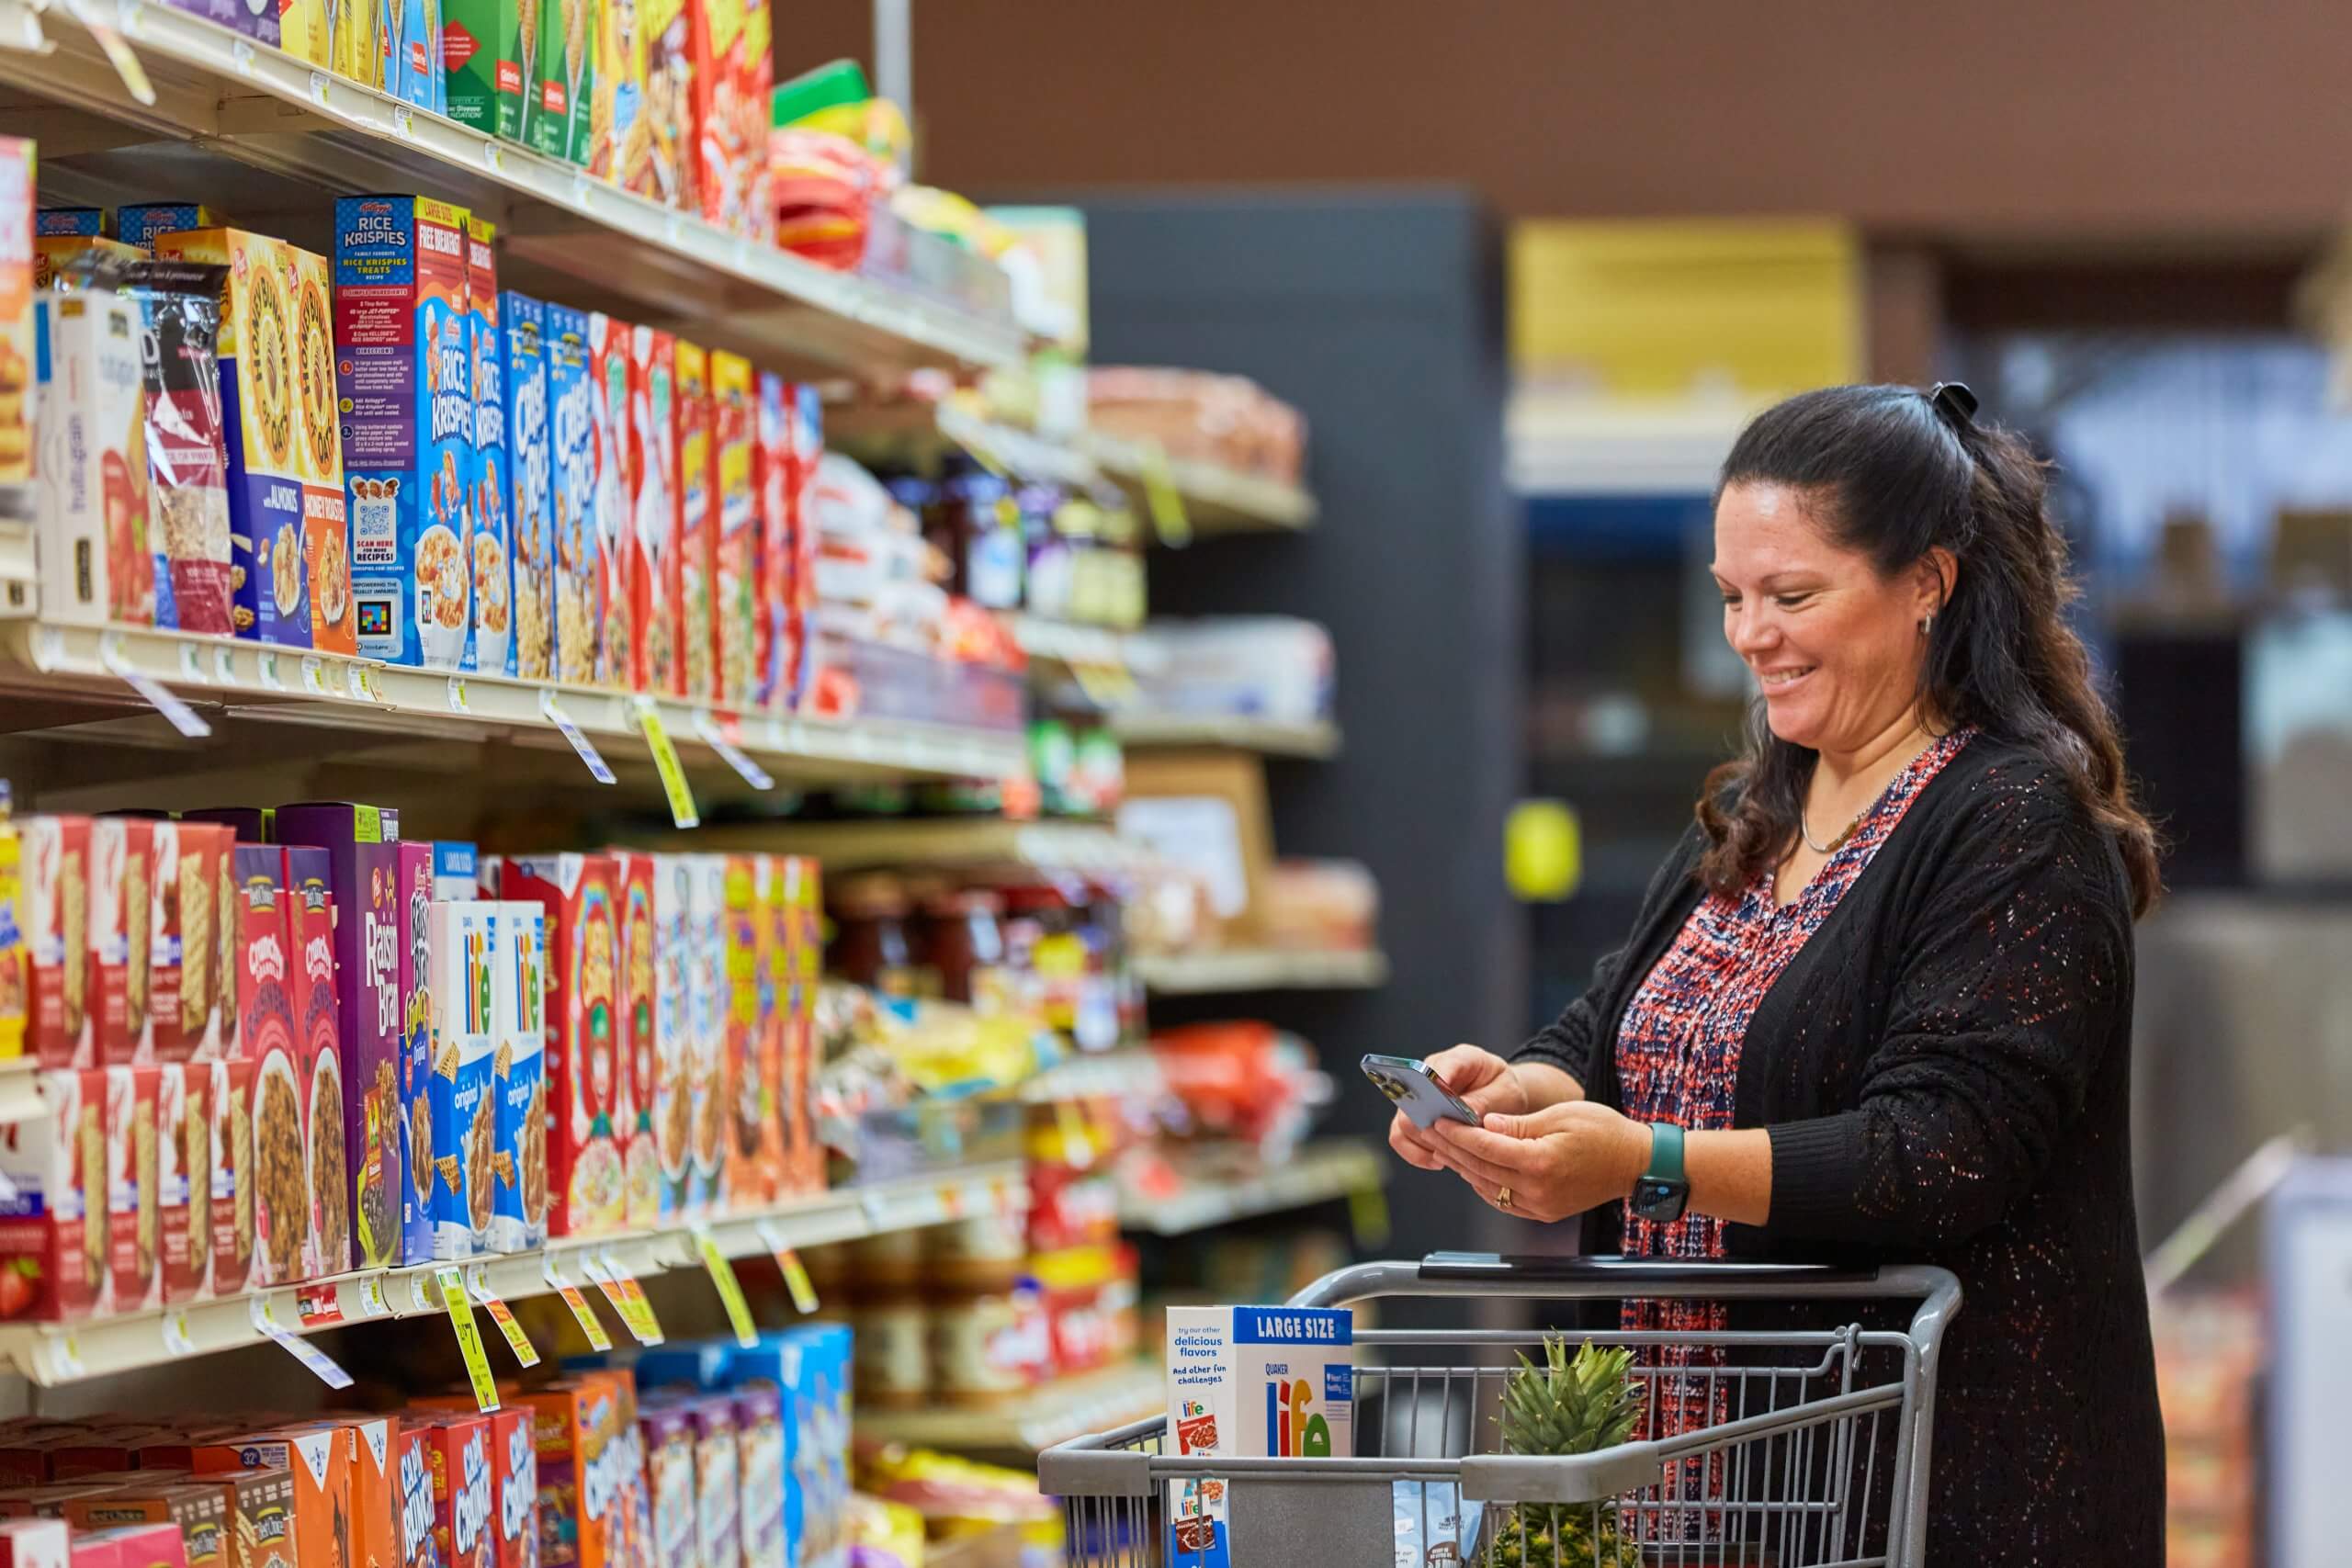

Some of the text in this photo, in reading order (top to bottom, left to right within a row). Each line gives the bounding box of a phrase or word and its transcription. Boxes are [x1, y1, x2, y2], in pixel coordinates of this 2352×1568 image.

[358, 217, 392, 231] RICE
[345, 231, 406, 247] KRISPIES
[366, 258, 407, 266] KRISPIES
[442, 350, 466, 394] RICE
[482, 361, 501, 405] RICE
[271, 484, 298, 513] ALMONDS
[305, 493, 322, 518] HONEY
[366, 910, 398, 987] Raisin
[464, 931, 491, 1035] life
[514, 932, 538, 1033] life
[378, 974, 398, 1037] Bran
[455, 1077, 478, 1112] original
[508, 1075, 529, 1109] original
[1257, 1316, 1335, 1339] LARGE SIZE
[1175, 1337, 1222, 1346] delicious
[1181, 1348, 1217, 1357] flavors
[1178, 1376, 1222, 1385] challenges
[1189, 1365, 1210, 1374] other
[1214, 1364, 1227, 1373] fun
[1265, 1363, 1288, 1376] QUAKER
[1183, 1400, 1204, 1417] life
[1266, 1379, 1331, 1457] life
[1182, 1500, 1199, 1516] life
